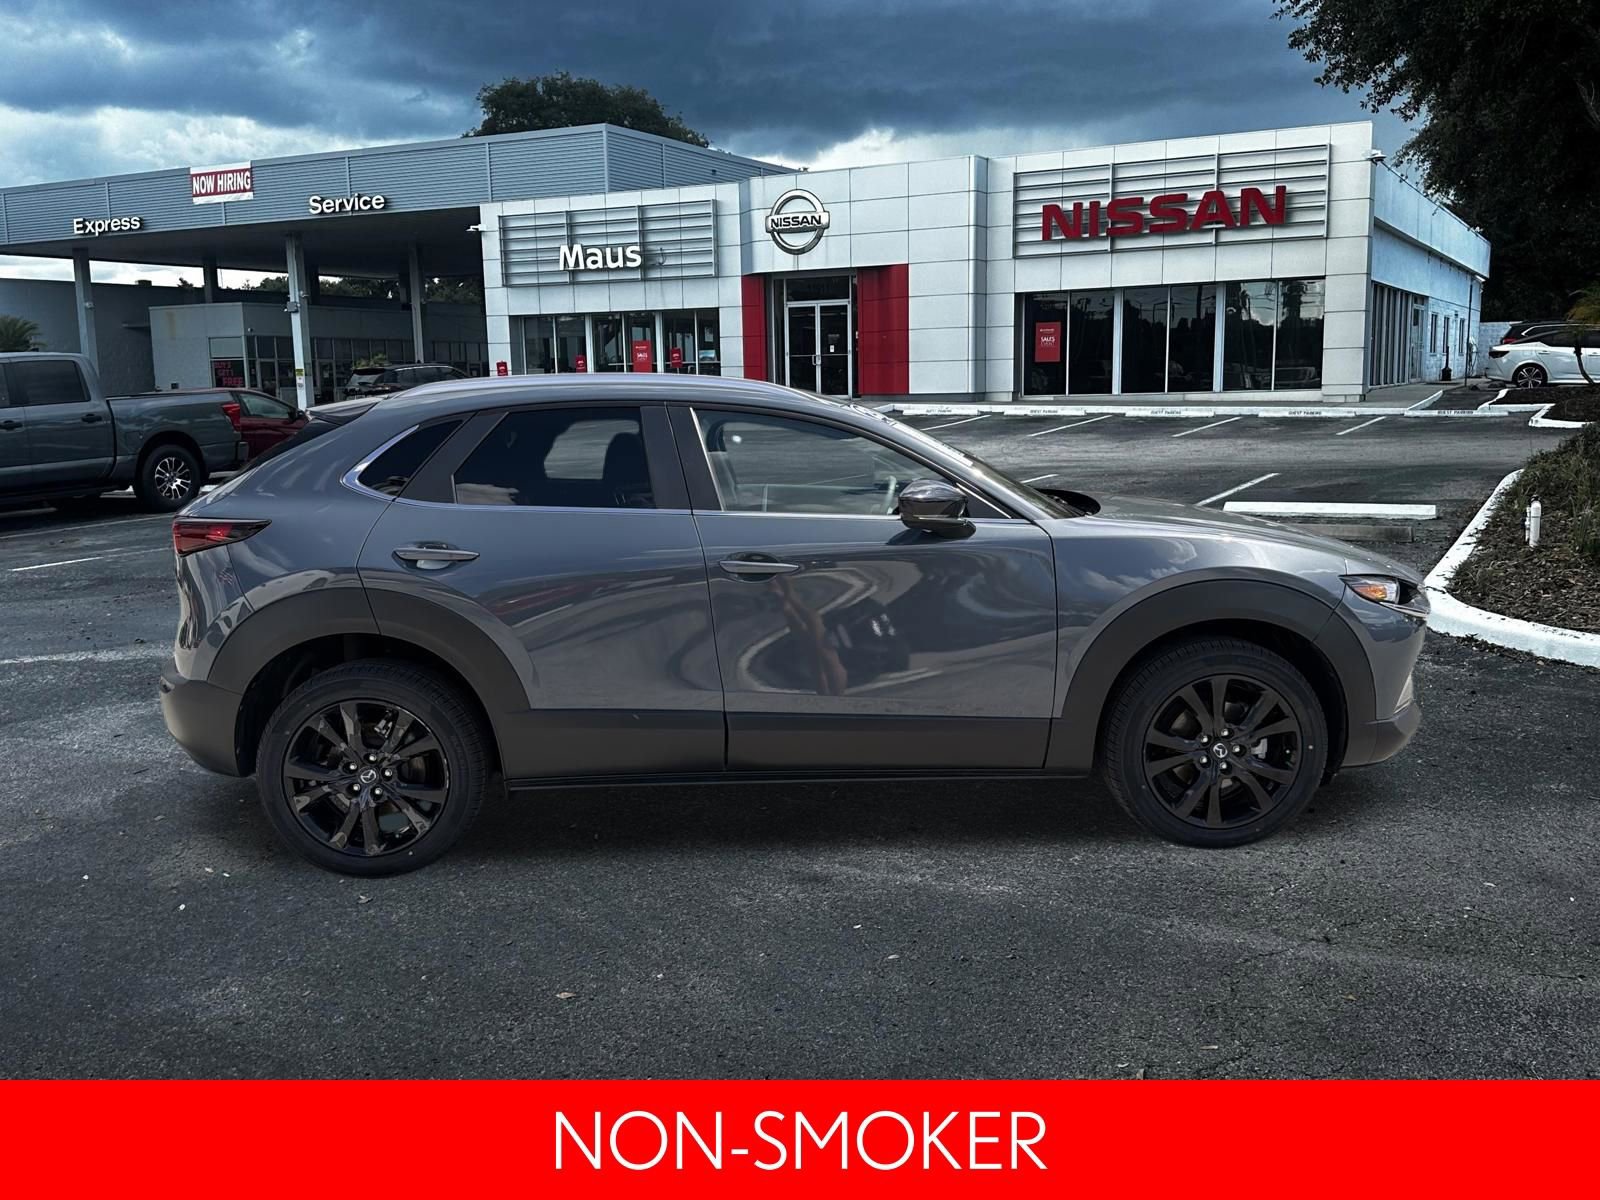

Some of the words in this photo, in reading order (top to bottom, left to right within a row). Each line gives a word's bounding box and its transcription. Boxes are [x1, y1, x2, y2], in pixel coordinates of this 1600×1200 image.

[193, 175, 215, 194] NOW
[217, 171, 251, 192] HIRING
[309, 193, 386, 215] Service
[1042, 185, 1287, 241] NISSAN
[73, 216, 141, 237] Express
[771, 215, 821, 228] NISSAN
[560, 244, 641, 270] Maus
